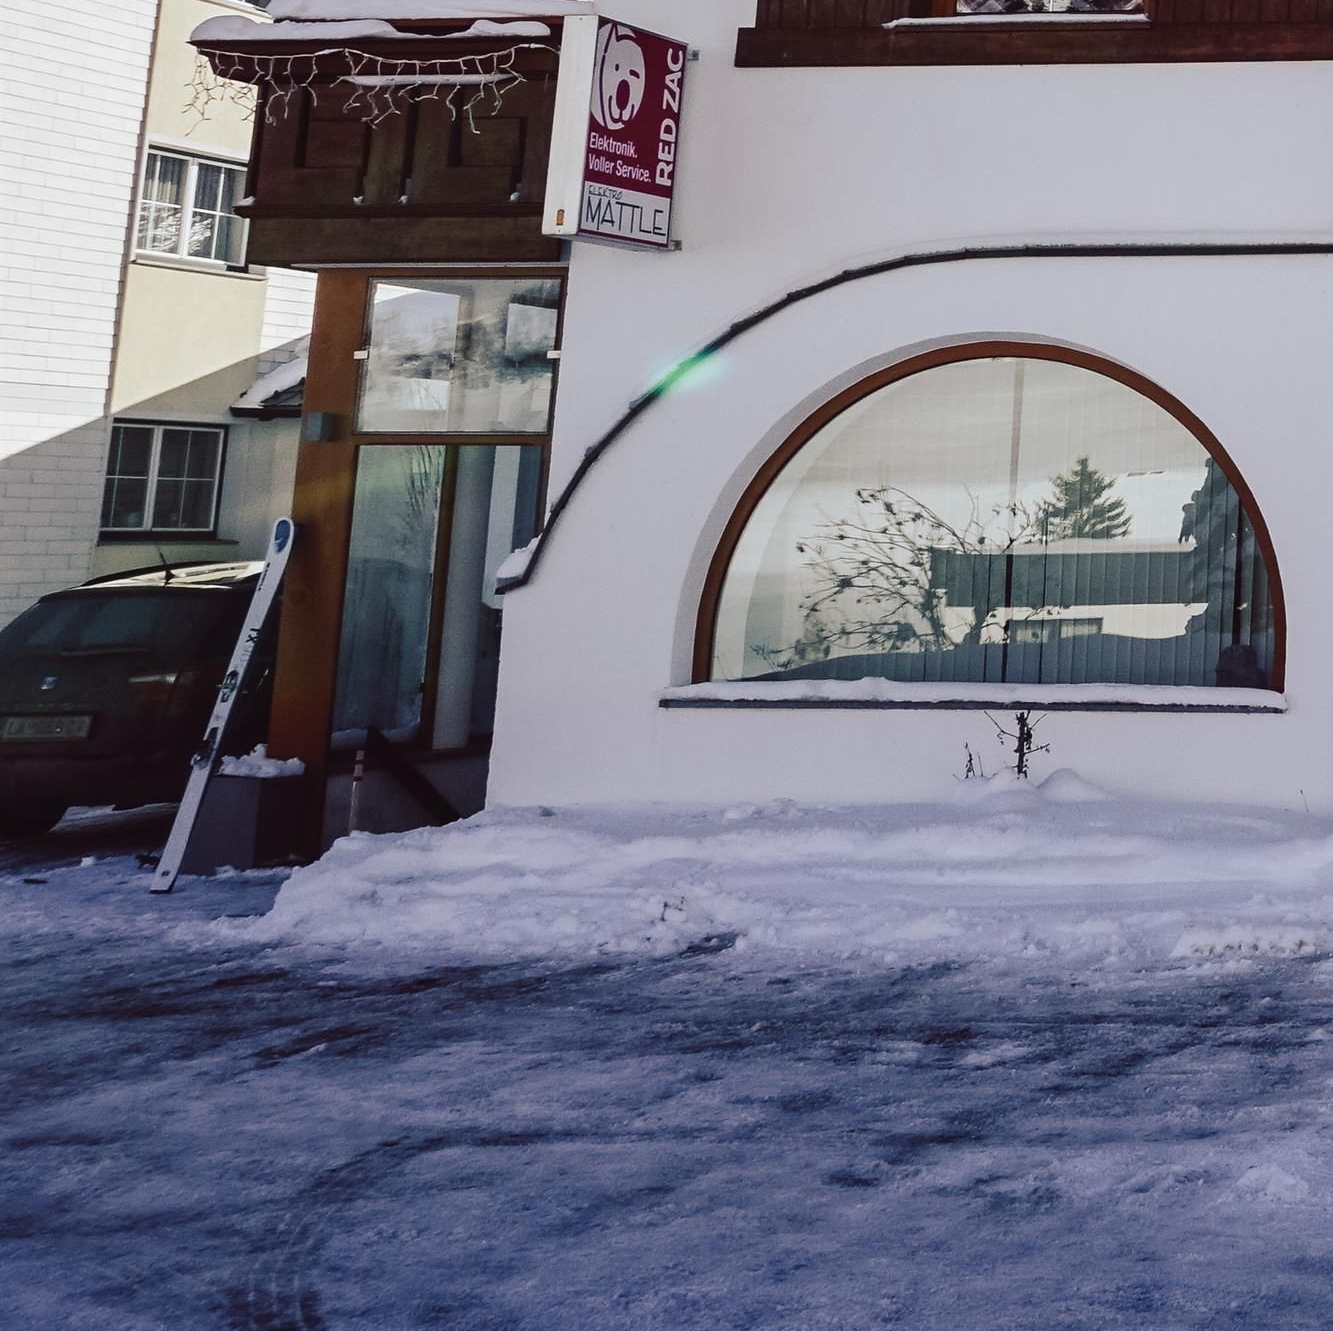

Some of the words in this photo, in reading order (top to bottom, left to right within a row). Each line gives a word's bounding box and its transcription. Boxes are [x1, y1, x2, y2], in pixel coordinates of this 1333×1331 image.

[663, 48, 683, 112] ZAC
[589, 132, 637, 158] Elektronik.
[656, 119, 676, 186] RED
[588, 153, 614, 174] Voller
[615, 160, 651, 182] Service.
[588, 185, 622, 199] ELEKTRO
[586, 196, 666, 236] MATTLE
